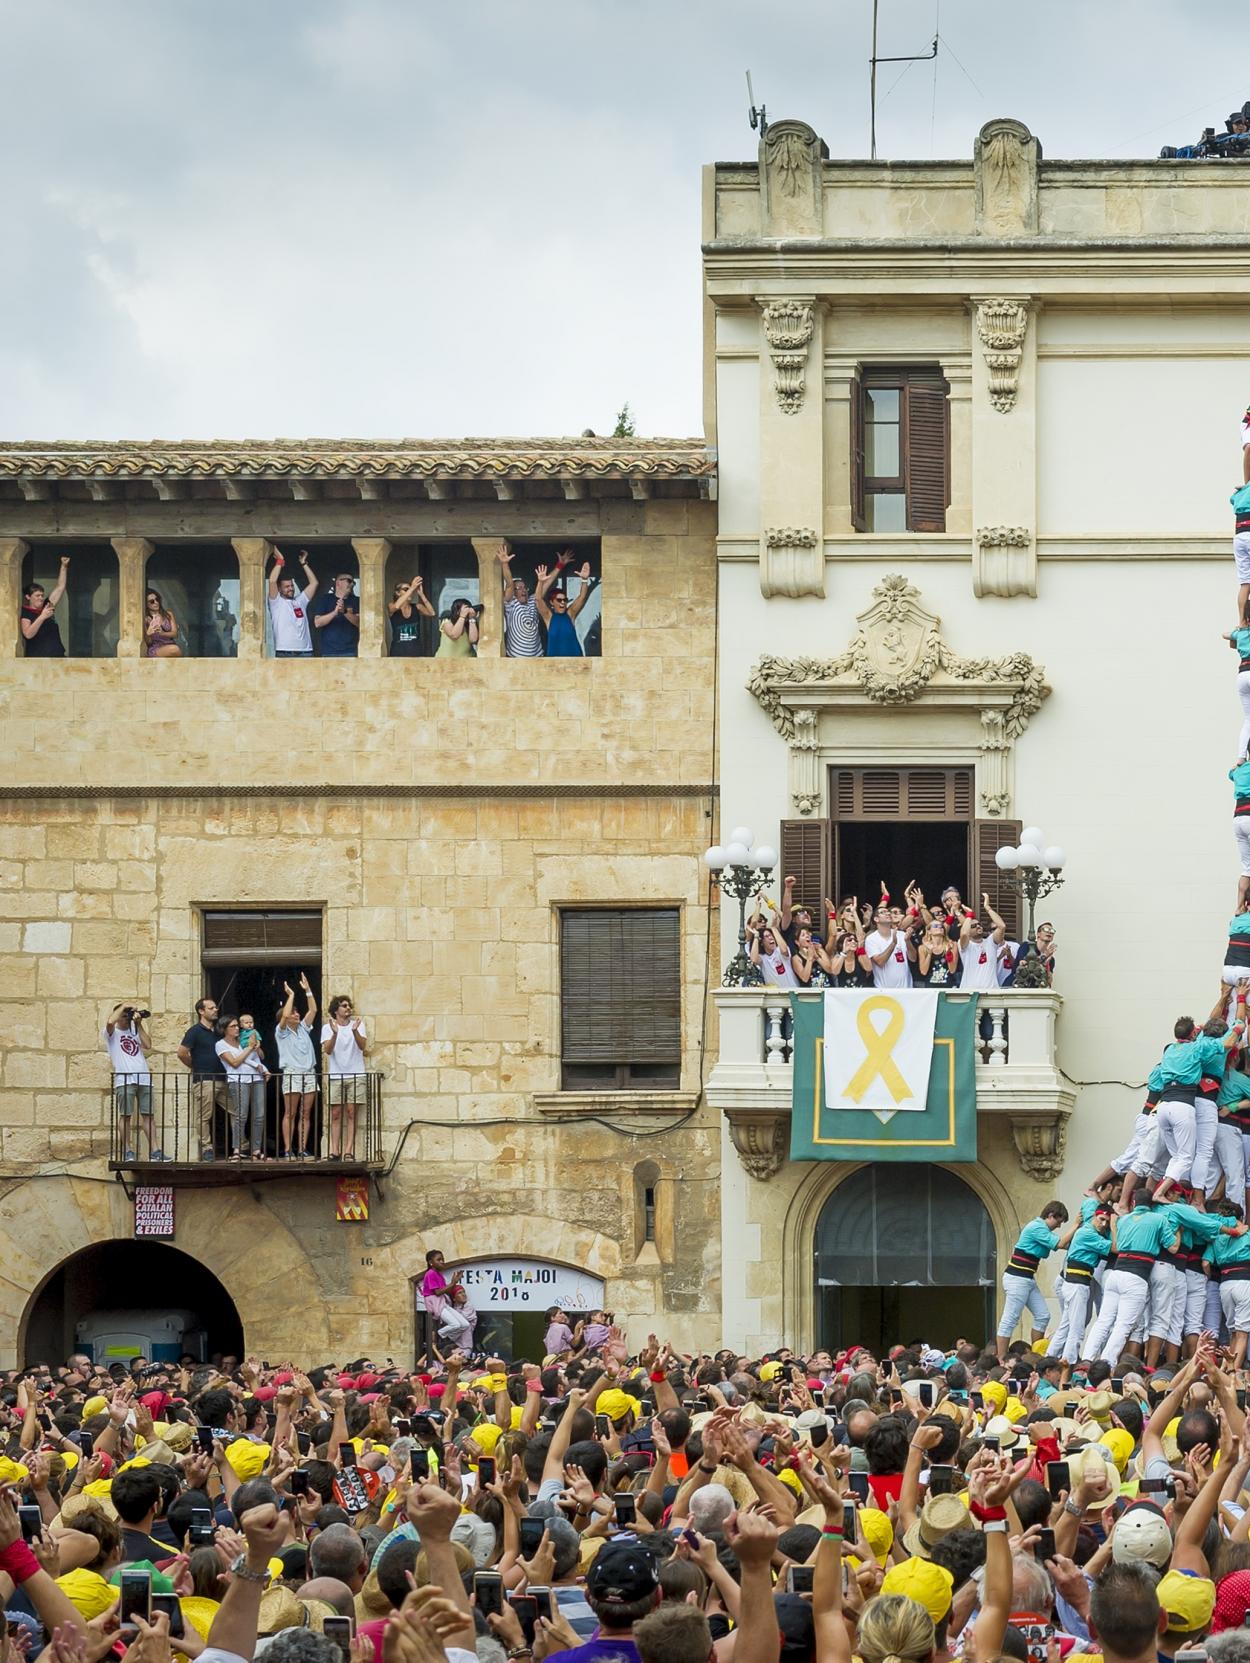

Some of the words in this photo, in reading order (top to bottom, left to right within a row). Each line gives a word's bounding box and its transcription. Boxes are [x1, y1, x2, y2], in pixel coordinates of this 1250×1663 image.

[136, 1187, 173, 1195] FREEDOM
[136, 1195, 155, 1204] FOR
[156, 1195, 173, 1204] ALL
[136, 1204, 173, 1212] CATALAN
[136, 1226, 144, 1235] &
[144, 1226, 173, 1235] EXILES
[360, 1257, 373, 1266] 16
